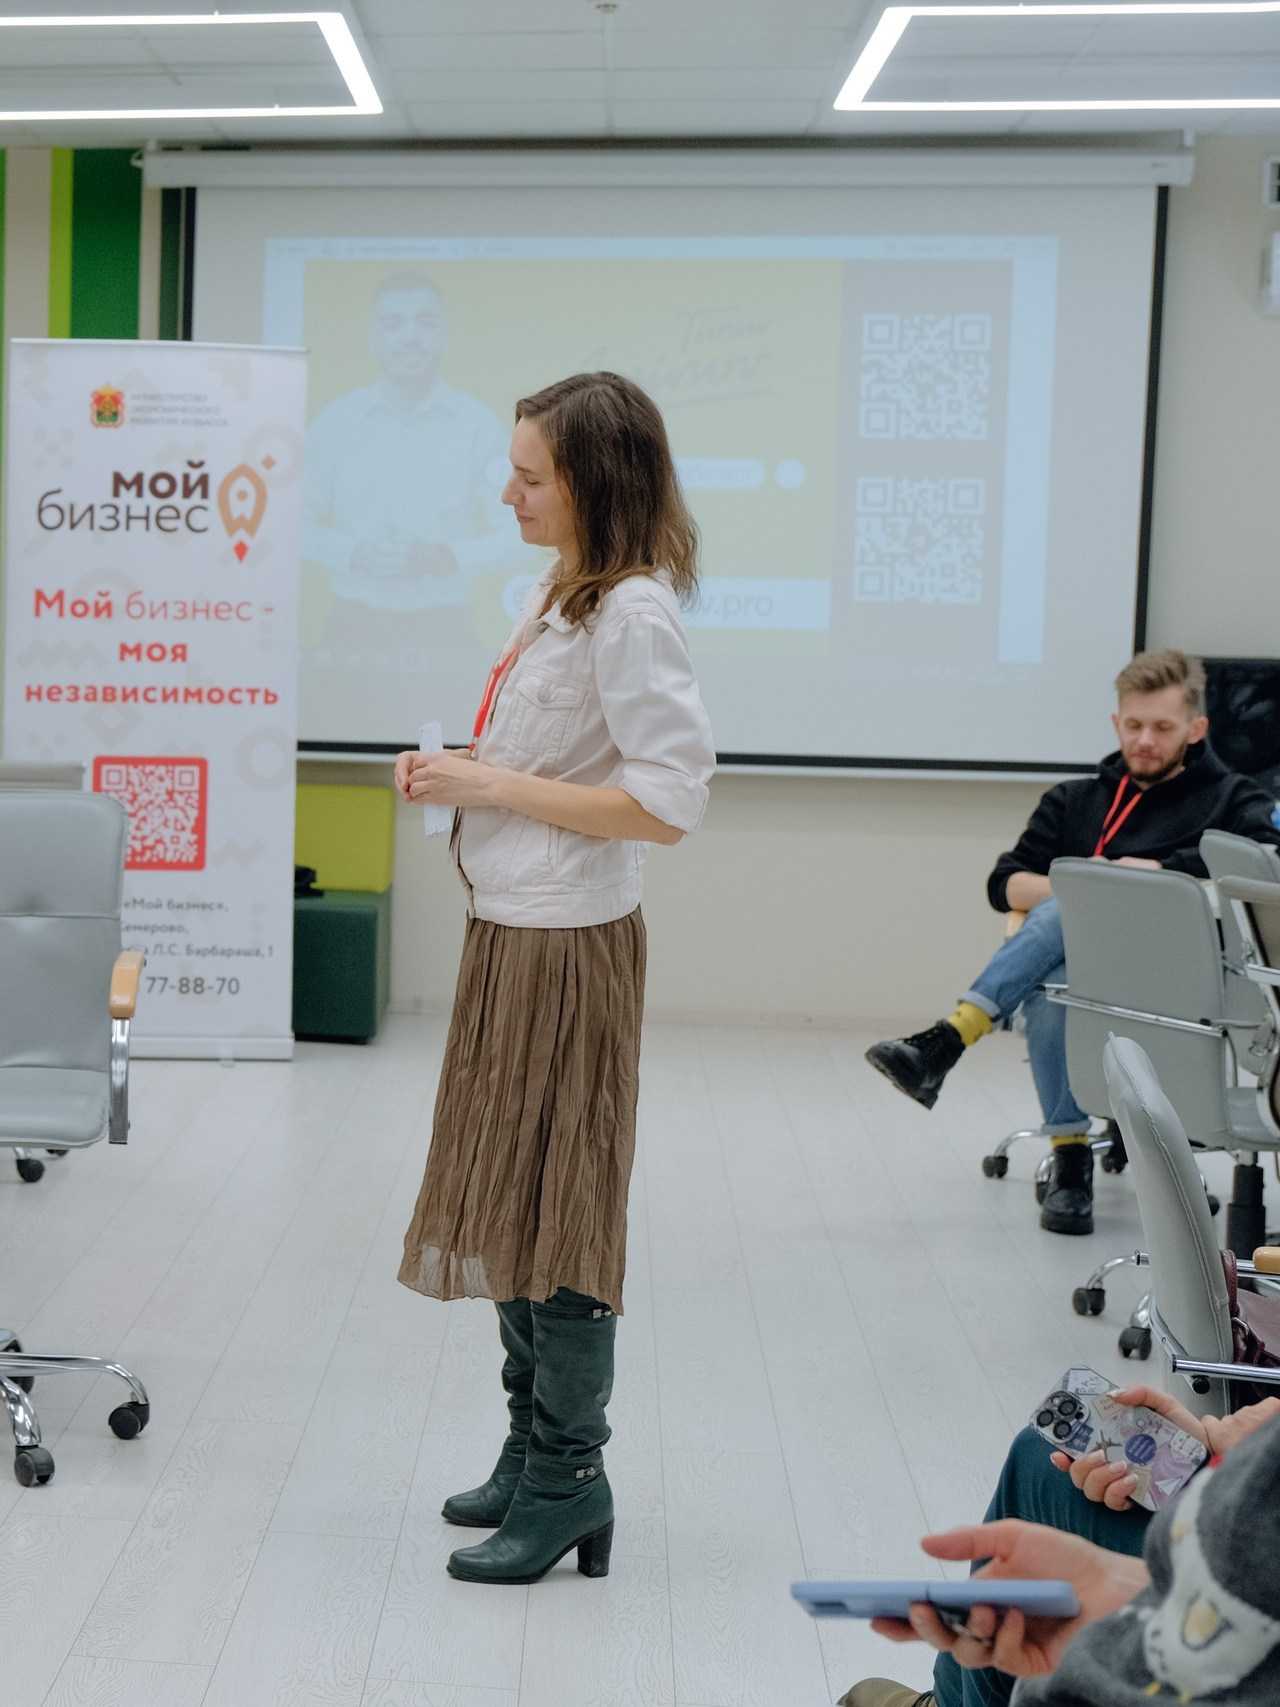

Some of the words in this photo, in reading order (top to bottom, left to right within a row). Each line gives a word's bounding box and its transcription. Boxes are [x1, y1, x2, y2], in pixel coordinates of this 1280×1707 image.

[112, 460, 210, 500] мой
[37, 488, 209, 533] бизнес
[34, 588, 113, 619] Мой
[126, 590, 253, 622] бизнес
[119, 642, 188, 663] моя
[25, 684, 279, 705] независимость
[124, 898, 163, 910] «Мой
[152, 943, 183, 956] Л.С.
[186, 943, 266, 958] Барбараша,
[268, 945, 274, 957] 1
[146, 976, 241, 996] 77-88-70
